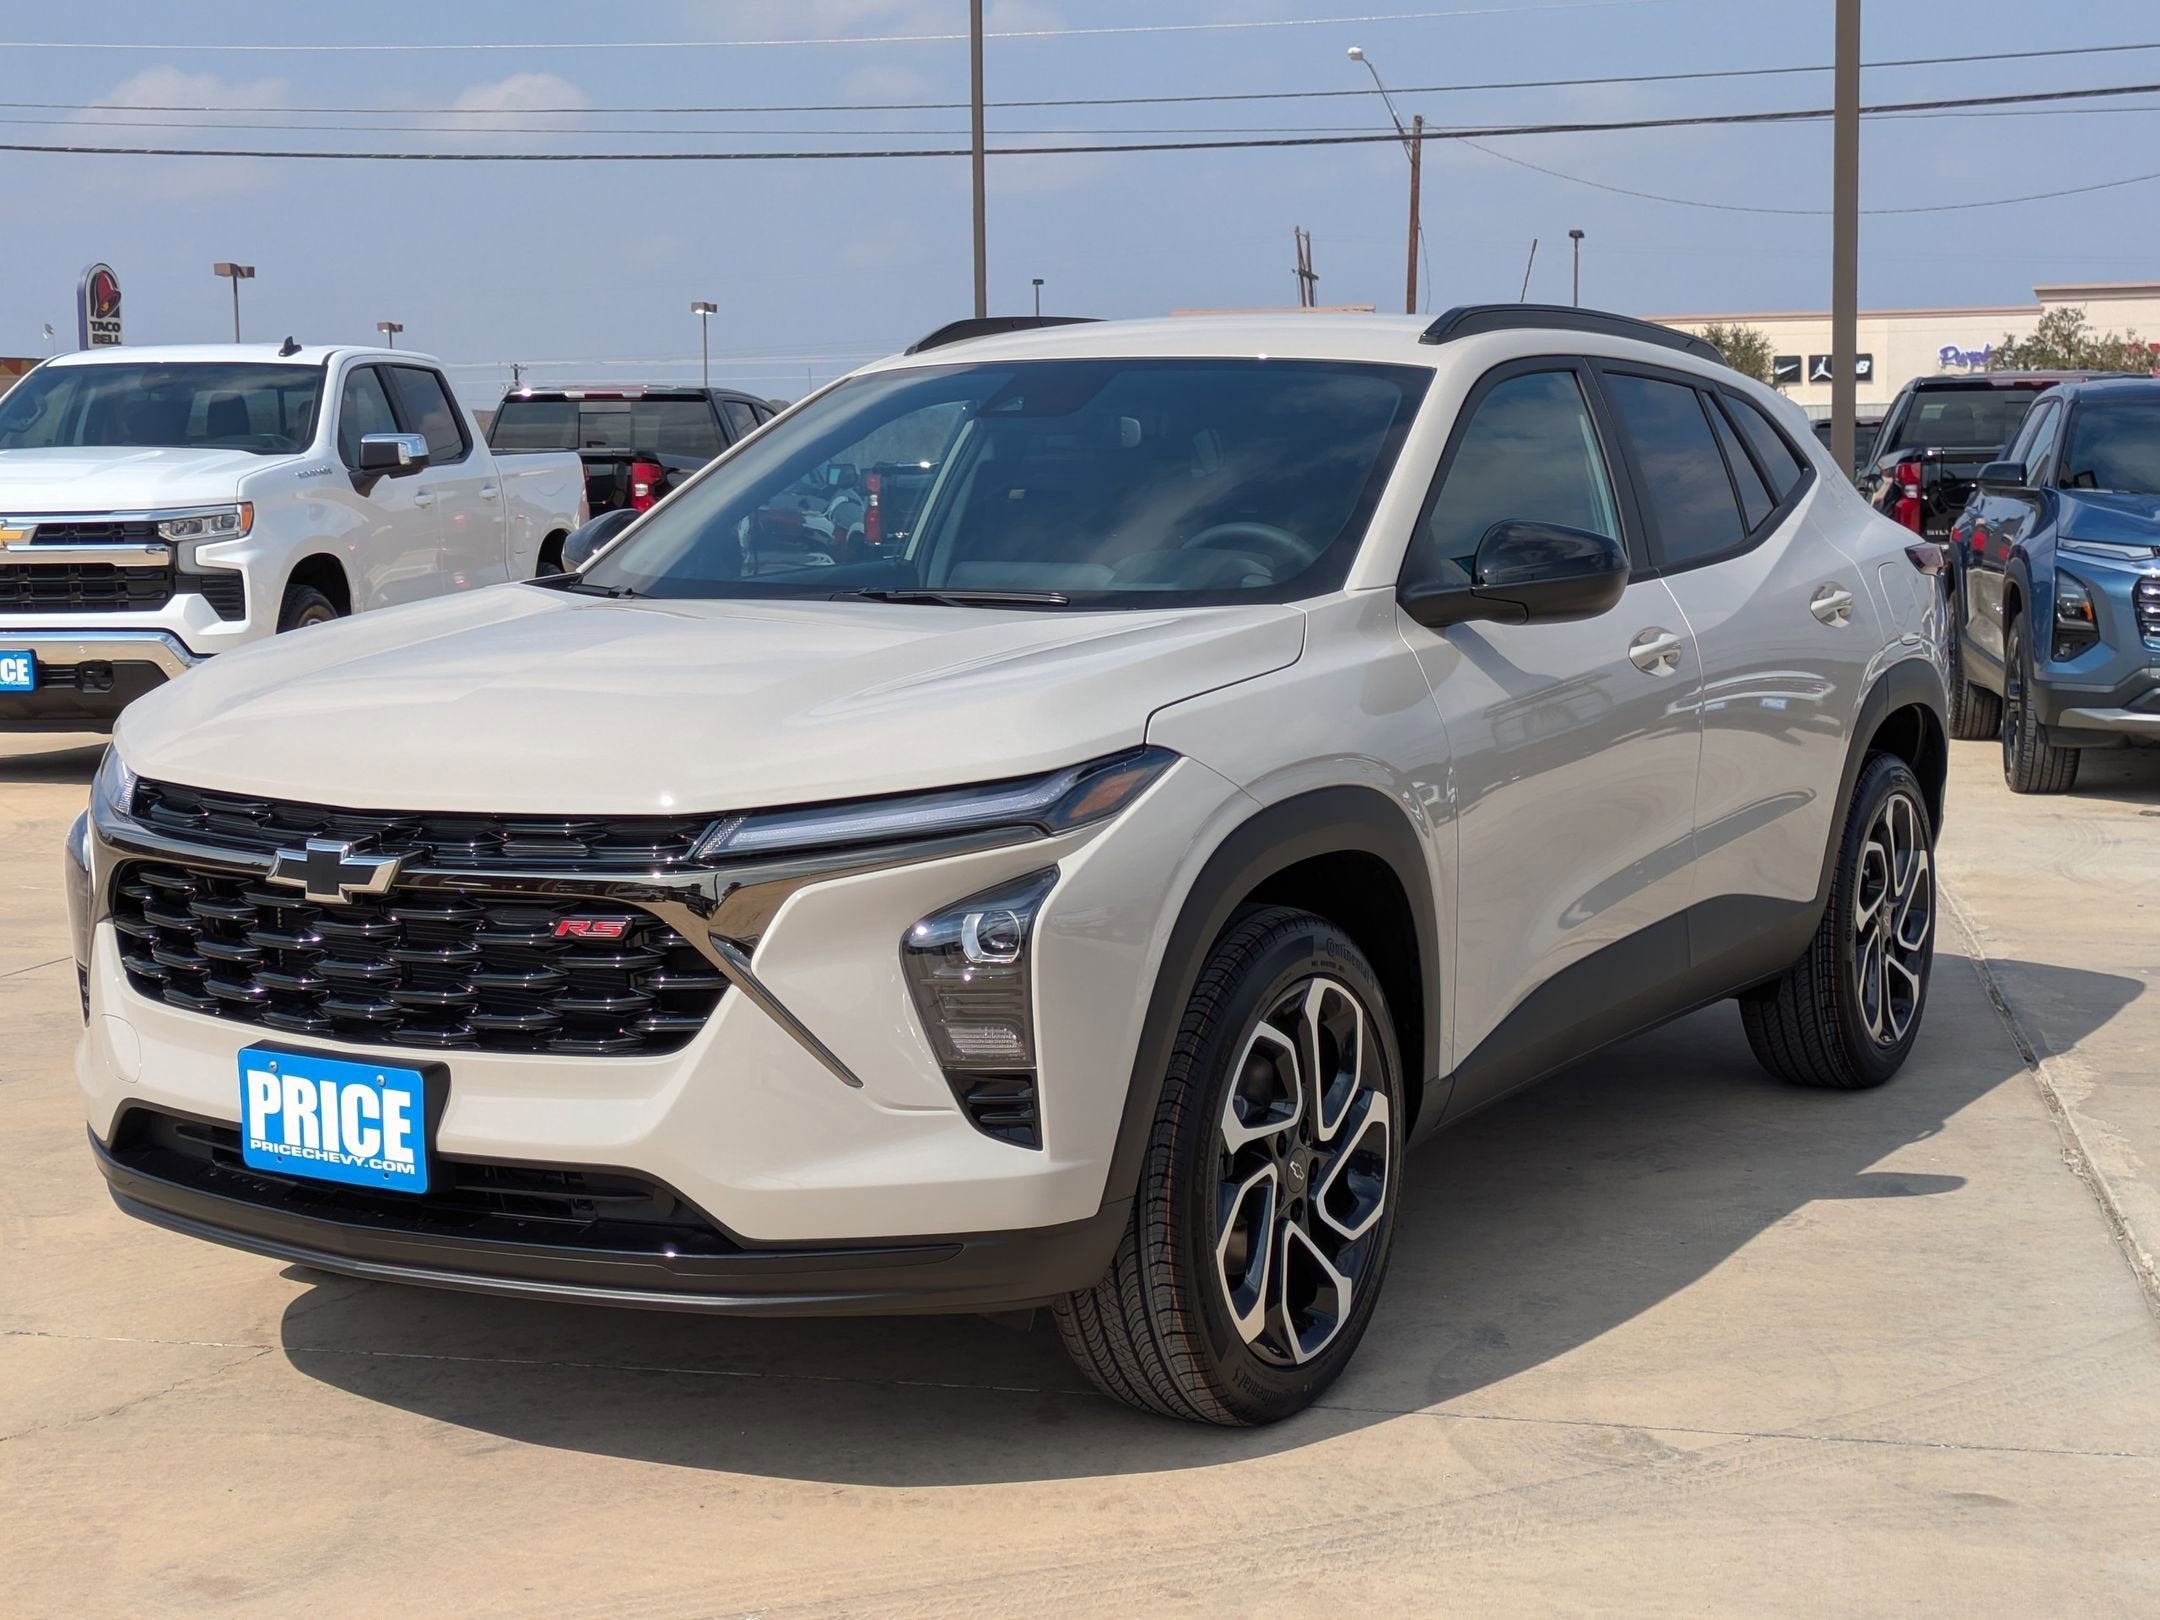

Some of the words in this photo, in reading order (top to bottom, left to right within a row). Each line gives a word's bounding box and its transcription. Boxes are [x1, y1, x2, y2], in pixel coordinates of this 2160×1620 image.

[90, 320, 121, 332] TACO
[92, 334, 121, 345] BELL
[554, 920, 626, 937] RS
[247, 1069, 414, 1164] PRICE
[250, 1139, 415, 1175] PRICECHEVY.COM
